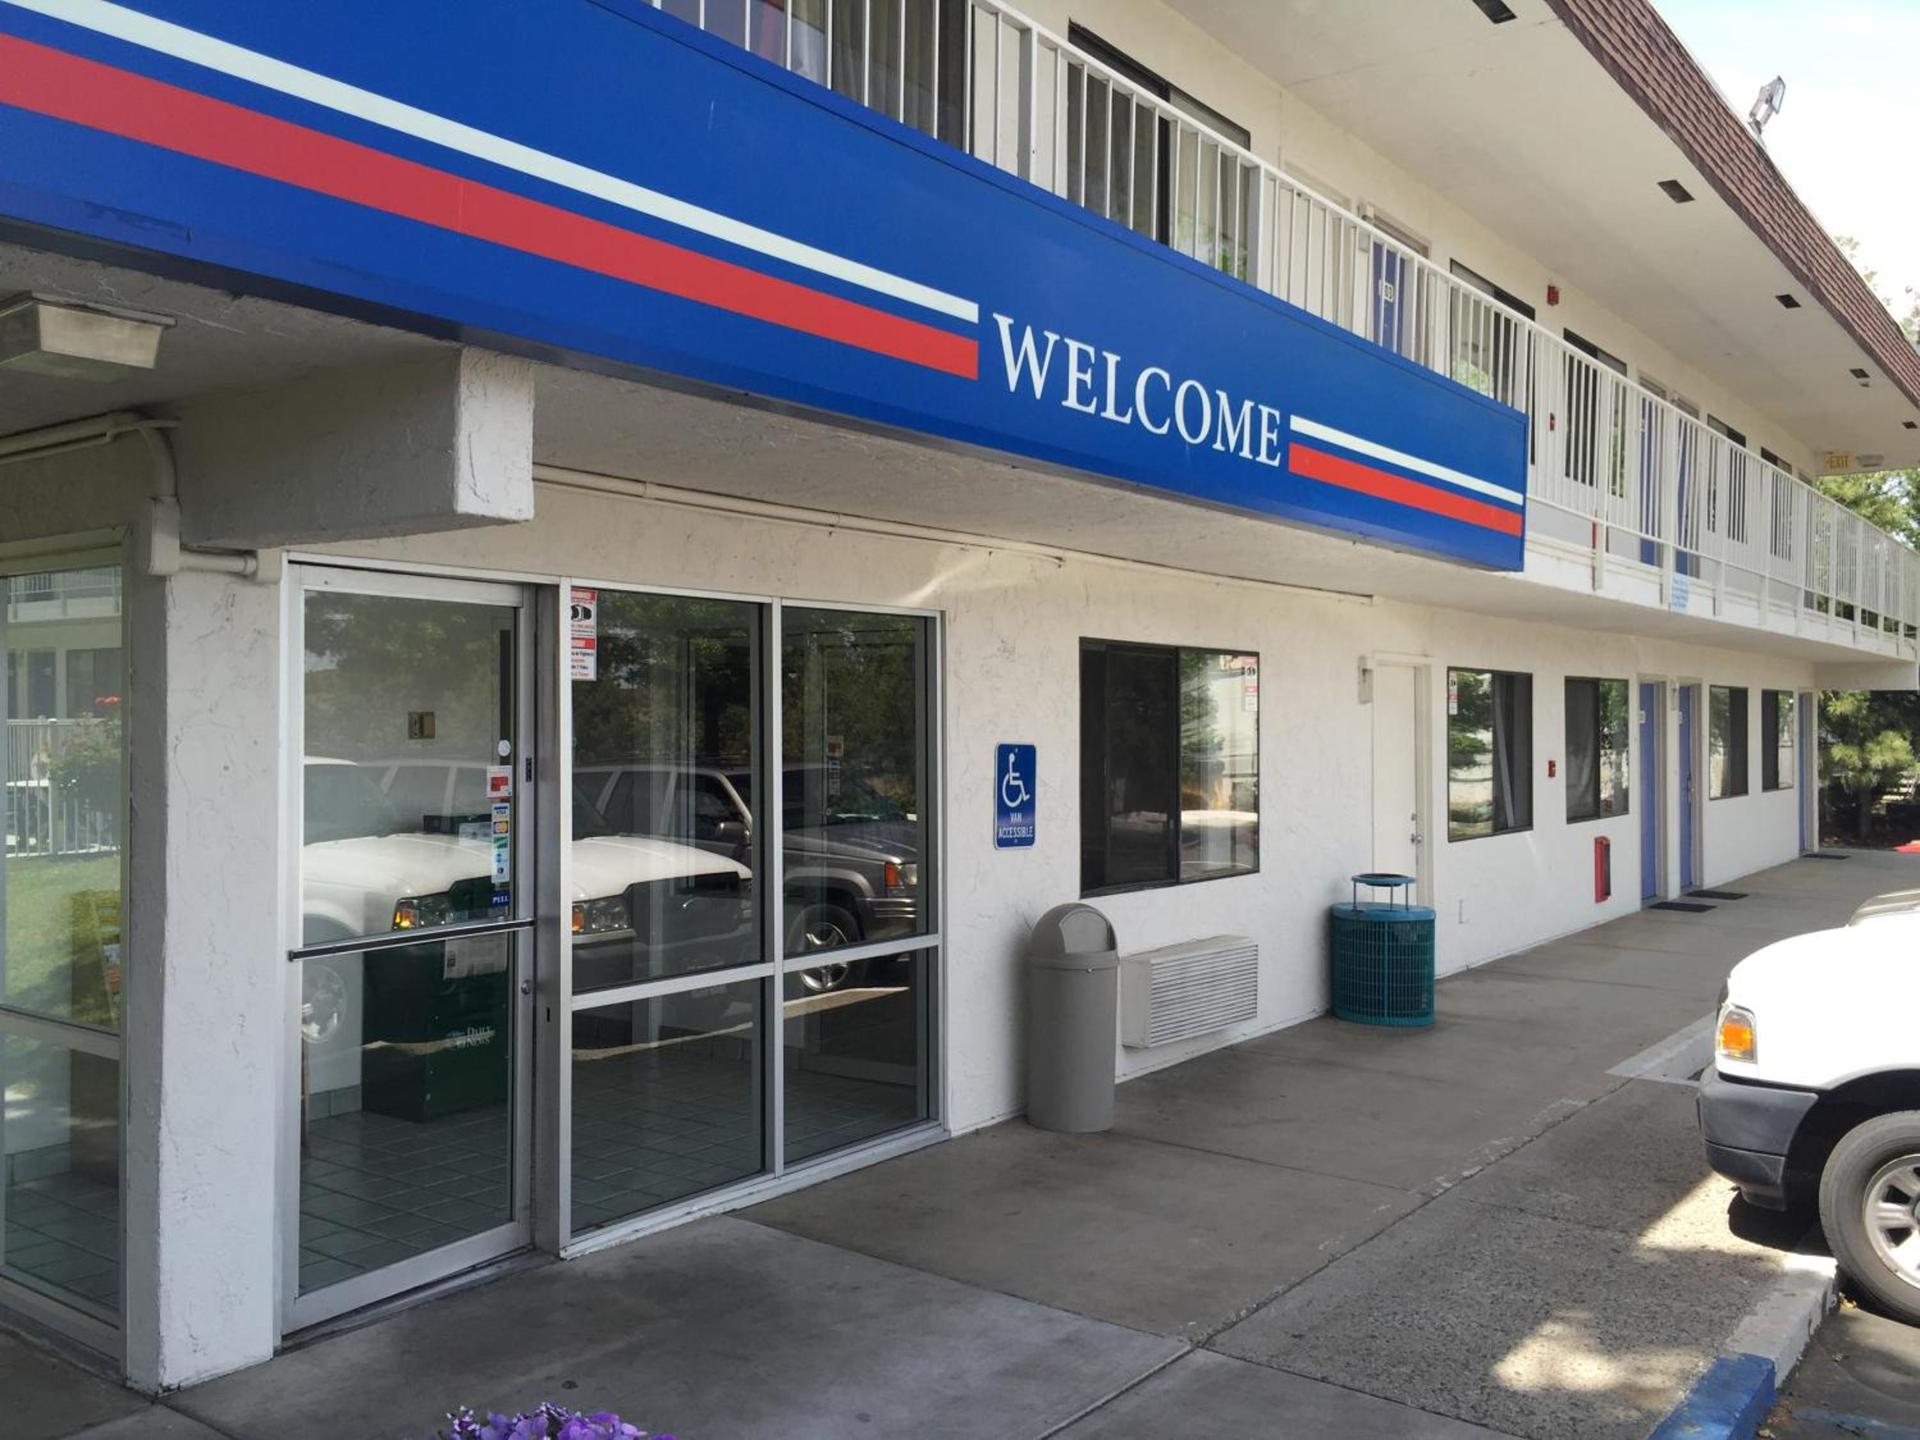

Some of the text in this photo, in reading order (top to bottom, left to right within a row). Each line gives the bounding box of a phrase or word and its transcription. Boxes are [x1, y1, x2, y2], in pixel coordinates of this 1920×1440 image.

[993, 312, 1281, 467] WELCOME
[1010, 812, 1022, 823] VAN
[998, 826, 1033, 838] ACCESSIBLE
[492, 895, 508, 904] PULL
